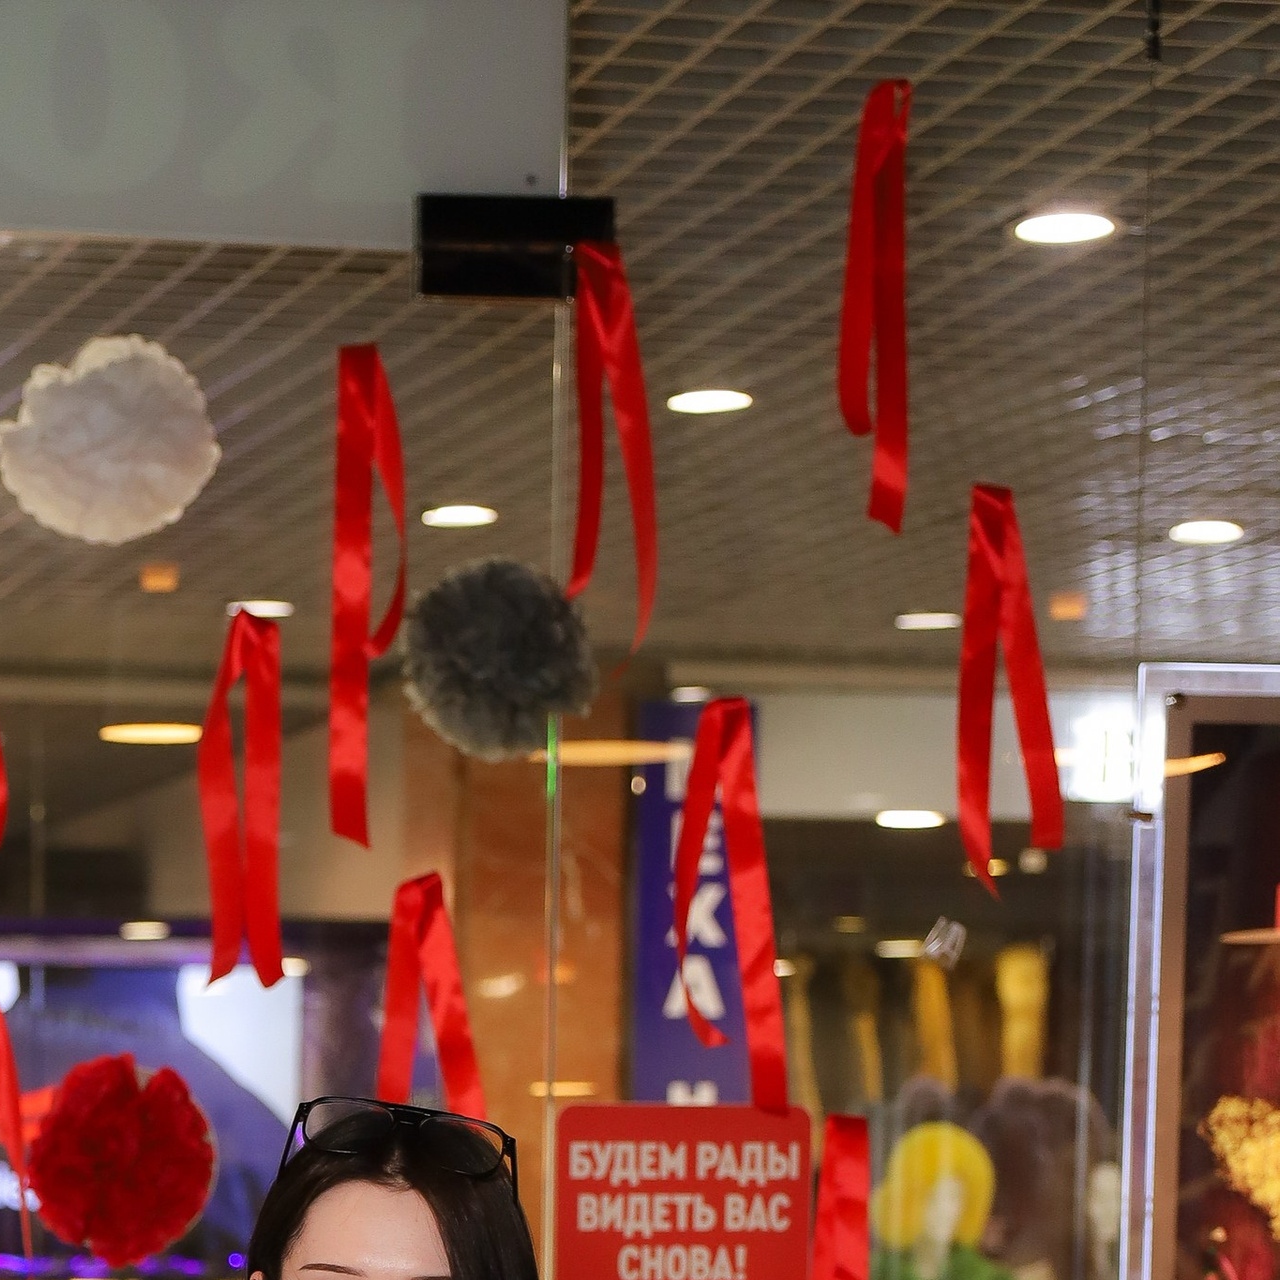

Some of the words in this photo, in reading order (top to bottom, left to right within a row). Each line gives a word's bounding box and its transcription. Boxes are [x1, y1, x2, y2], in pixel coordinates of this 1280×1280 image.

[569, 1141, 688, 1187] БУДЕМ
[695, 1141, 801, 1188] РАДЫ
[577, 1192, 717, 1239] ВИДЕТЬ
[723, 1192, 792, 1232] ВАС
